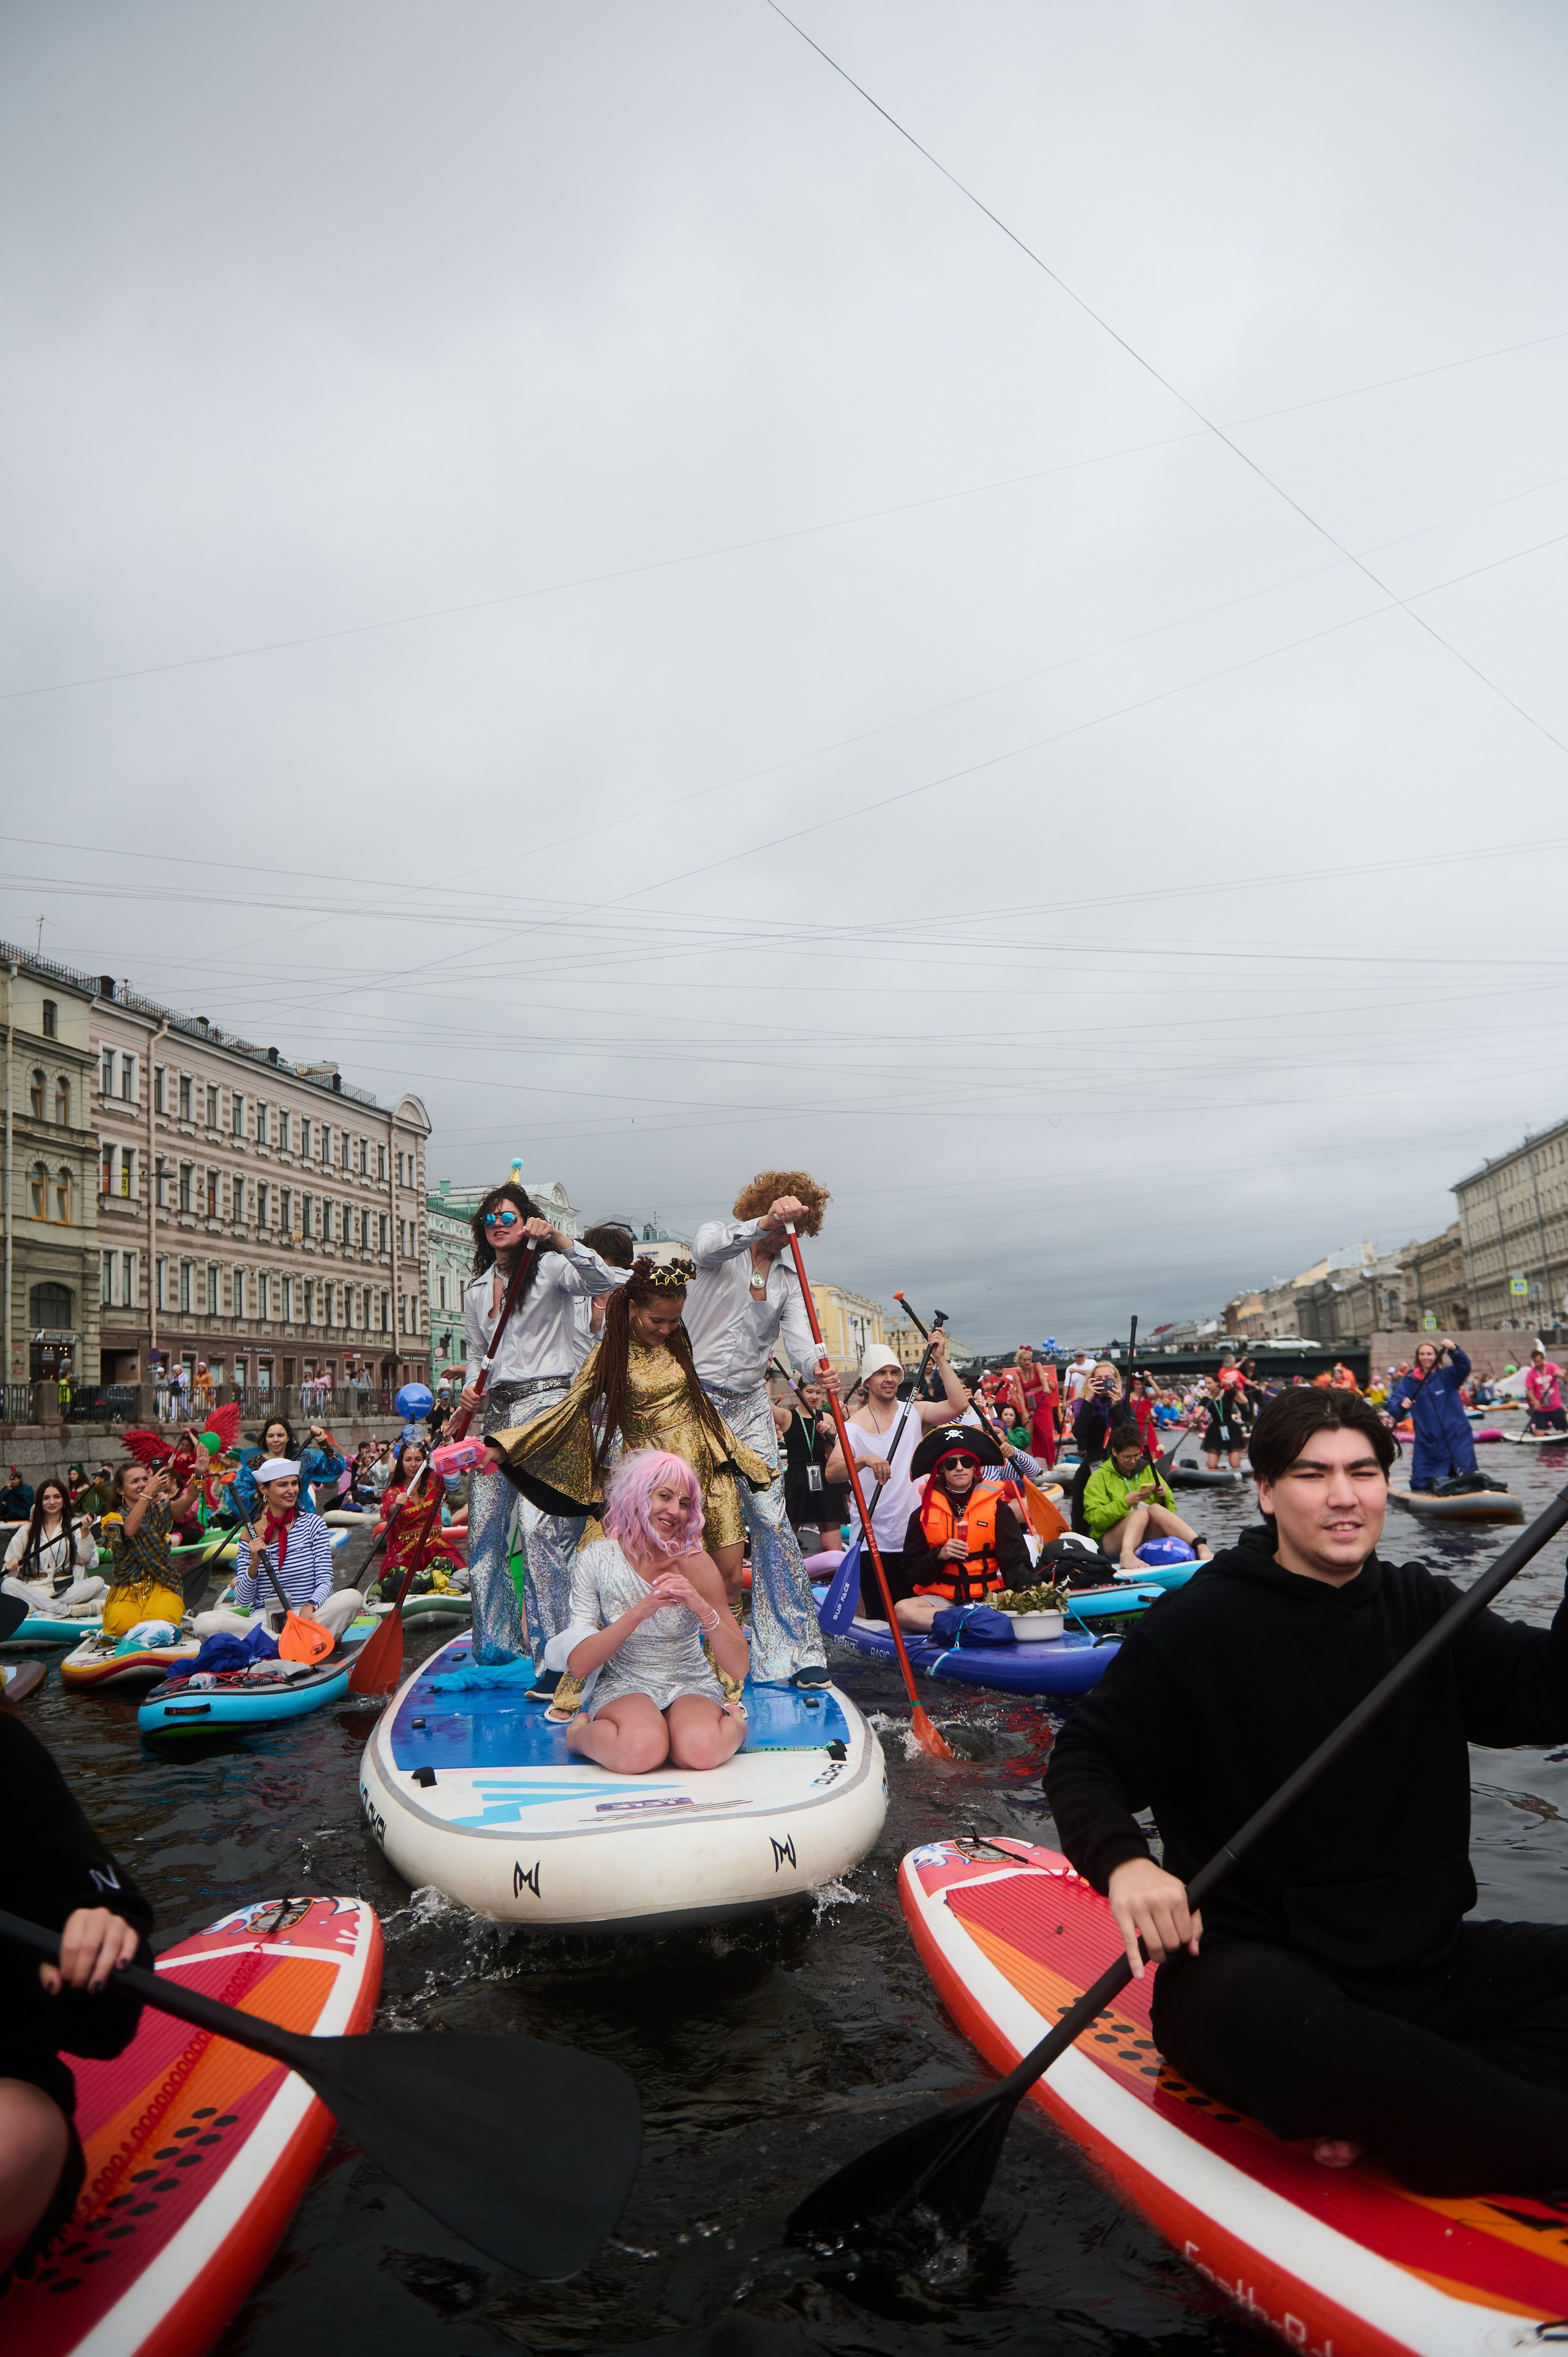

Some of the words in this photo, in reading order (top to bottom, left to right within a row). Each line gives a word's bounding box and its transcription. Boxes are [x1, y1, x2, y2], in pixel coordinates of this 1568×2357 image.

[865, 1523, 880, 1557] ITIWIT
[833, 1604, 842, 1620] SUP
[840, 1582, 850, 1602] FACE
